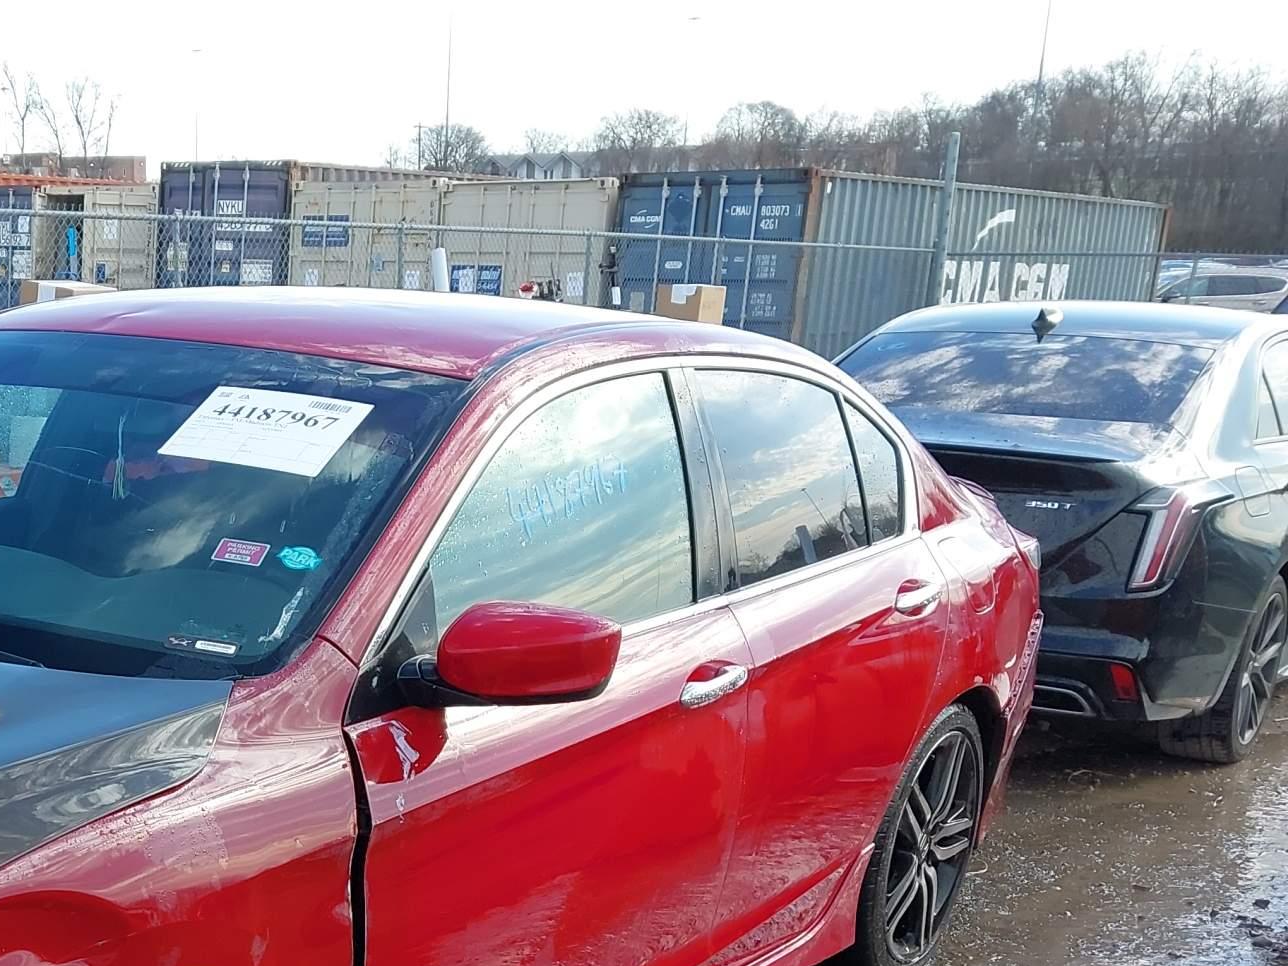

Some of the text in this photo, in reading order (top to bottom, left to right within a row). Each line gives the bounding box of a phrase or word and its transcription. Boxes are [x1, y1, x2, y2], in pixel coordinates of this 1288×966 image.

[217, 200, 243, 215] NYKU
[730, 204, 752, 216] CMAU
[941, 260, 1070, 305] CMA CGM
[212, 403, 340, 430] 44187967
